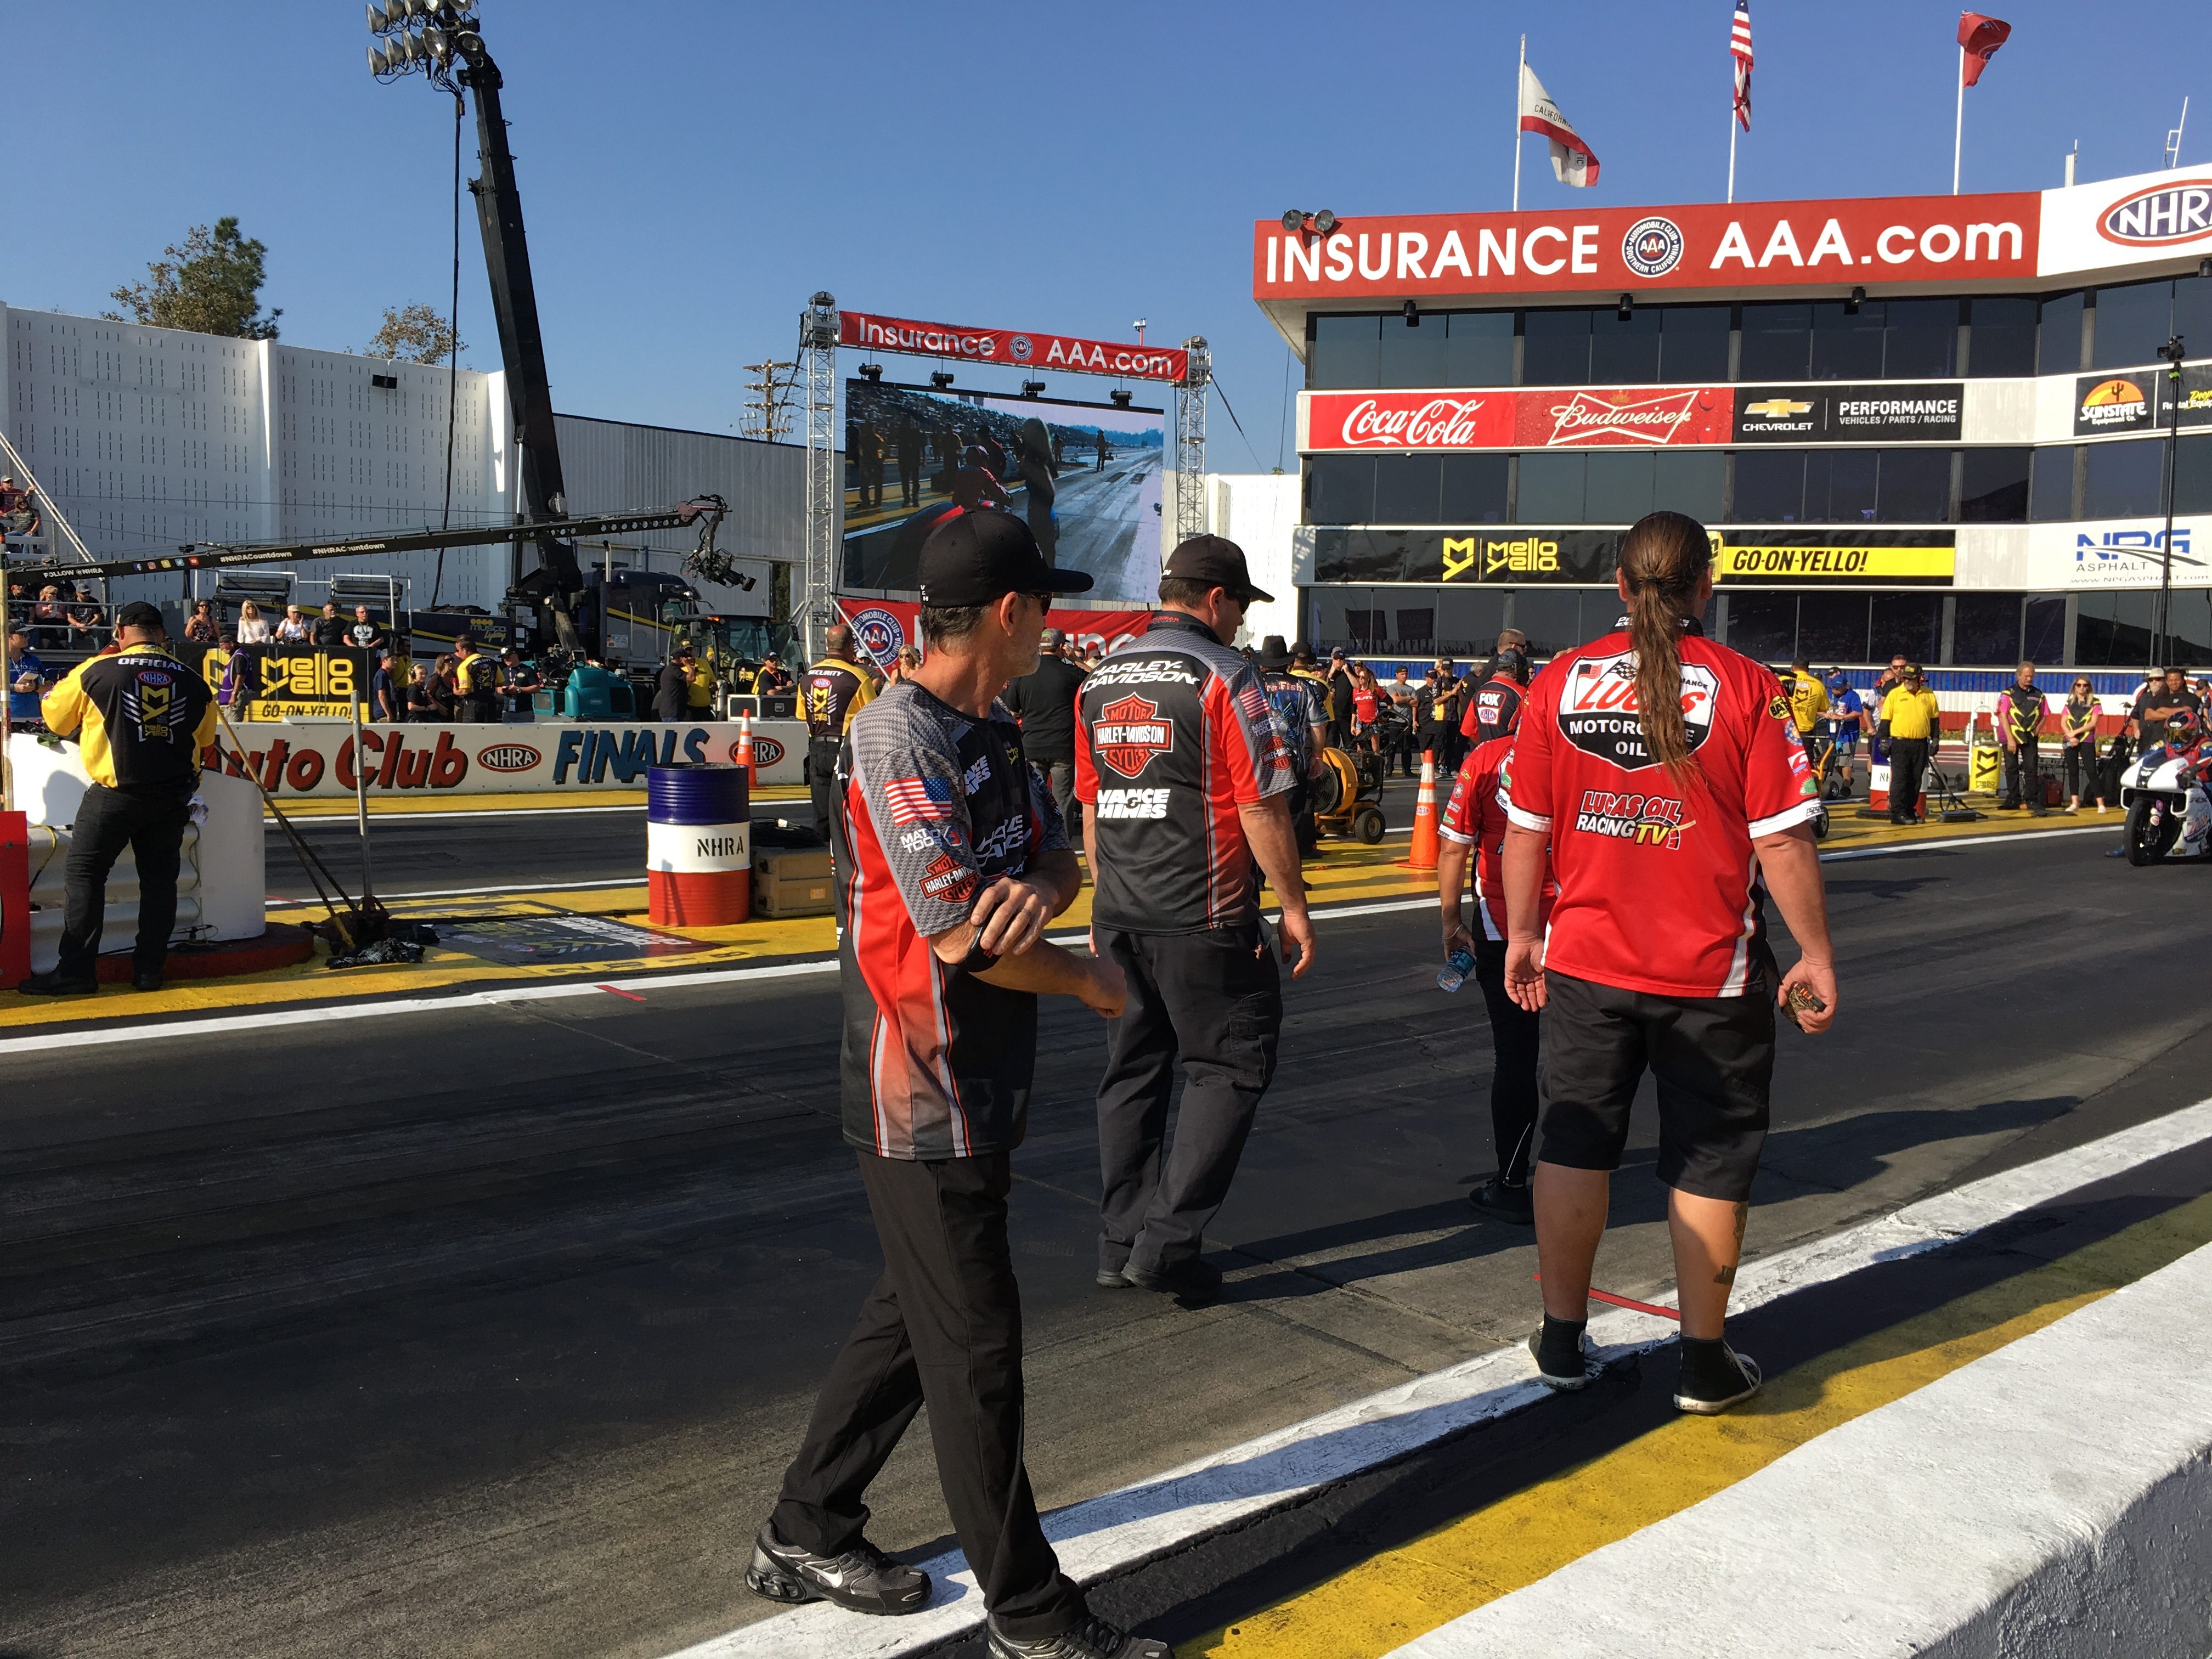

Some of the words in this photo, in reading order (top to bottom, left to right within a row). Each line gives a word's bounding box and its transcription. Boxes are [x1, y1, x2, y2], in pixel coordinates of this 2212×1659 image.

[2119, 190, 2212, 235] NHR
[1628, 221, 1666, 243] AUTOMOBILE
[1664, 225, 1678, 241] CLUB
[1266, 225, 1599, 284] INSURANCE
[1709, 218, 2023, 270] AAA.com
[1640, 238, 1666, 253] AAA
[1626, 245, 1650, 273] SOUTHERN
[1651, 244, 1679, 273] CALIFORNIA
[859, 317, 996, 357] Insurance
[1046, 338, 1172, 376] AAA.com
[1839, 399, 1957, 416] PERFORMANCE
[2079, 402, 2147, 421] SUNSTATE
[2162, 400, 2188, 410] Retal
[1341, 398, 1486, 445] Coca-Cola
[1550, 404, 1691, 428] Budweiser
[1839, 416, 1881, 425] VEHICLES
[1888, 415, 1916, 424] PARTS
[1923, 415, 1956, 424] RACING
[2092, 415, 2125, 425] Equipment
[1742, 422, 1814, 432] CHEVROLET
[2076, 529, 2191, 561] NPG
[43, 569, 74, 579] FOLLOW
[75, 568, 104, 576] @NHRA
[219, 551, 292, 563] #NHRACountdown
[1733, 550, 1869, 572] GO-ON-YELLO!
[2076, 561, 2148, 572] ASPHALT
[887, 617, 900, 634] CLUB
[863, 629, 888, 644] AAA
[117, 658, 185, 672] OFFICIAL
[1090, 661, 1183, 679] HARLEY-
[143, 673, 168, 684] NHRA
[1081, 671, 1201, 693] DAVIDSON
[1479, 692, 1501, 707] FOX
[1573, 680, 1707, 714] LUCS
[1110, 701, 1147, 721] MOTOR
[1097, 725, 1165, 745] HARLEY-DAVIDSON
[1615, 741, 1648, 757] OIL
[335, 729, 469, 790] Club
[487, 748, 534, 767] NHRA
[552, 729, 710, 784] FINALS
[1109, 748, 1145, 771] CYCLES
[1097, 788, 1171, 804] VANCE
[1097, 803, 1167, 819] HINES
[1580, 791, 1645, 820] LUCAS
[1643, 796, 1682, 824] OIL
[1575, 814, 1637, 838] RACING
[1635, 823, 1669, 845] TV
[697, 836, 744, 857] NHRA
